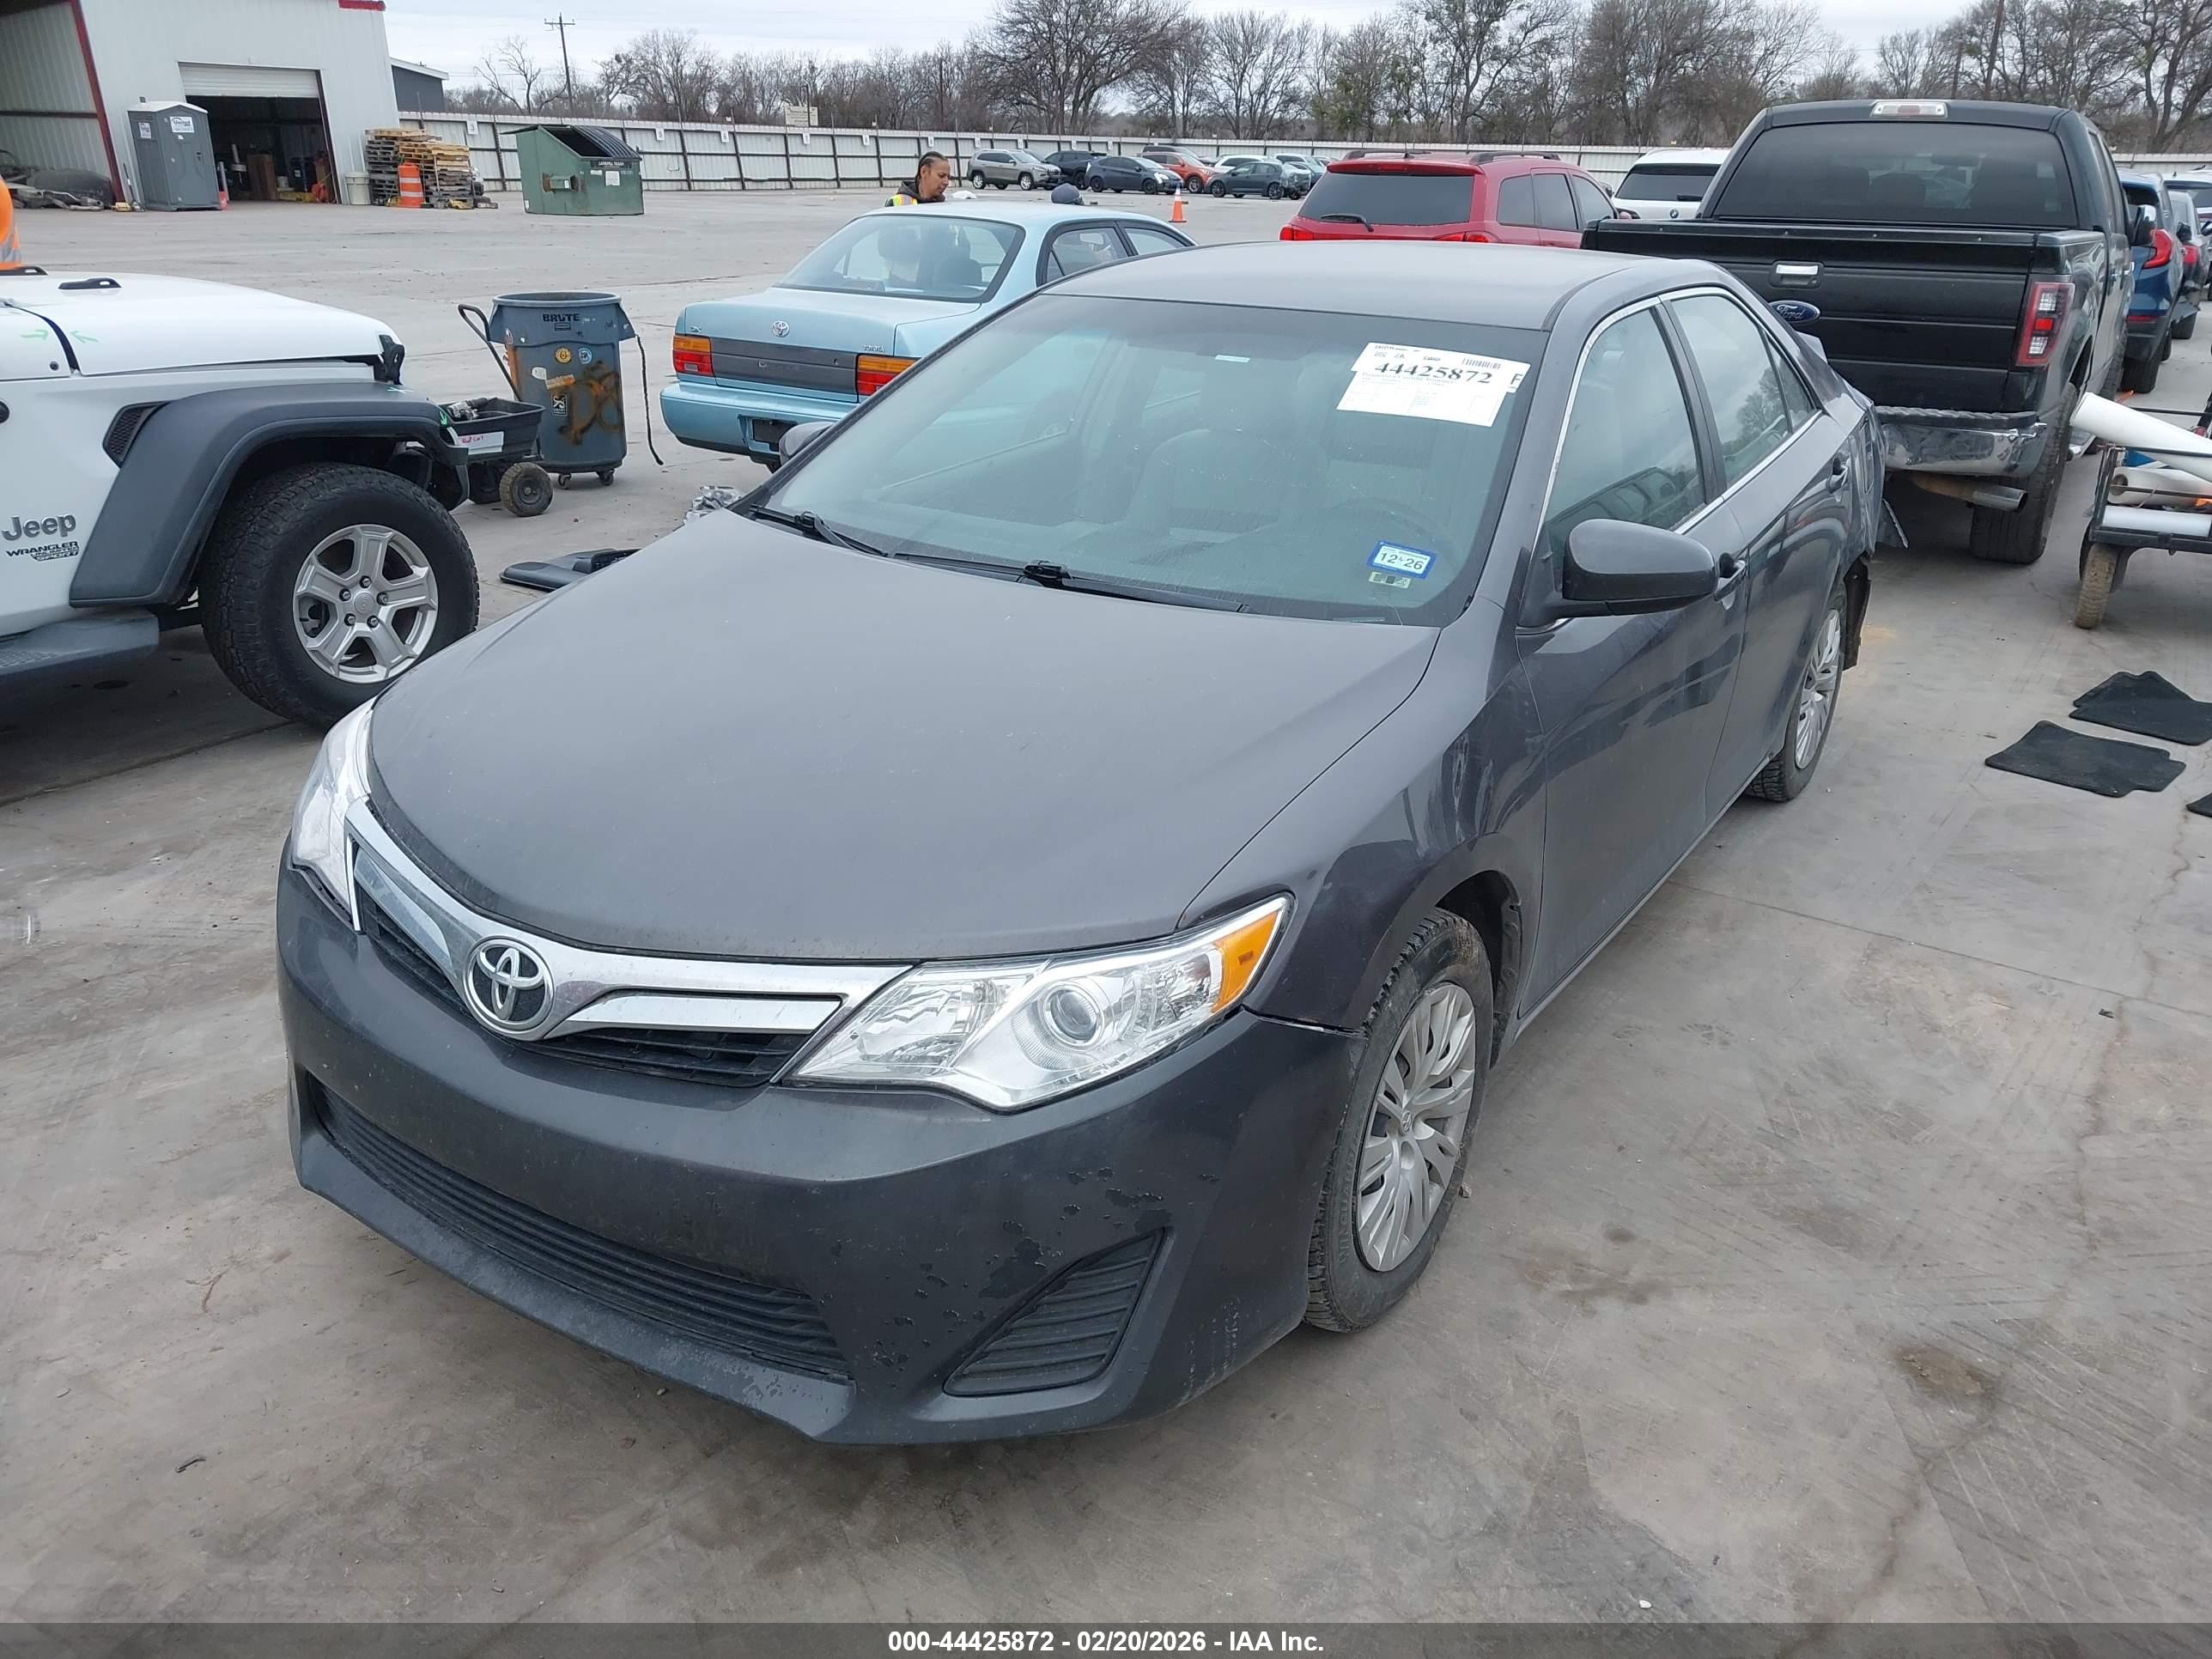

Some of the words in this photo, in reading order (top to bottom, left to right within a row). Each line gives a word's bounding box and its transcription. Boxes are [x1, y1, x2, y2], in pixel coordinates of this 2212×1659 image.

[542, 313, 580, 322] BRUTE
[1777, 304, 1806, 319] Ford
[1375, 362, 1493, 384] 44425872
[1510, 373, 1523, 385] F
[2, 514, 76, 541] Jeep
[6, 541, 79, 557] WRANGLER
[36, 550, 78, 561] SPORT
[1380, 552, 1398, 564] 12
[1403, 557, 1424, 570] 26
